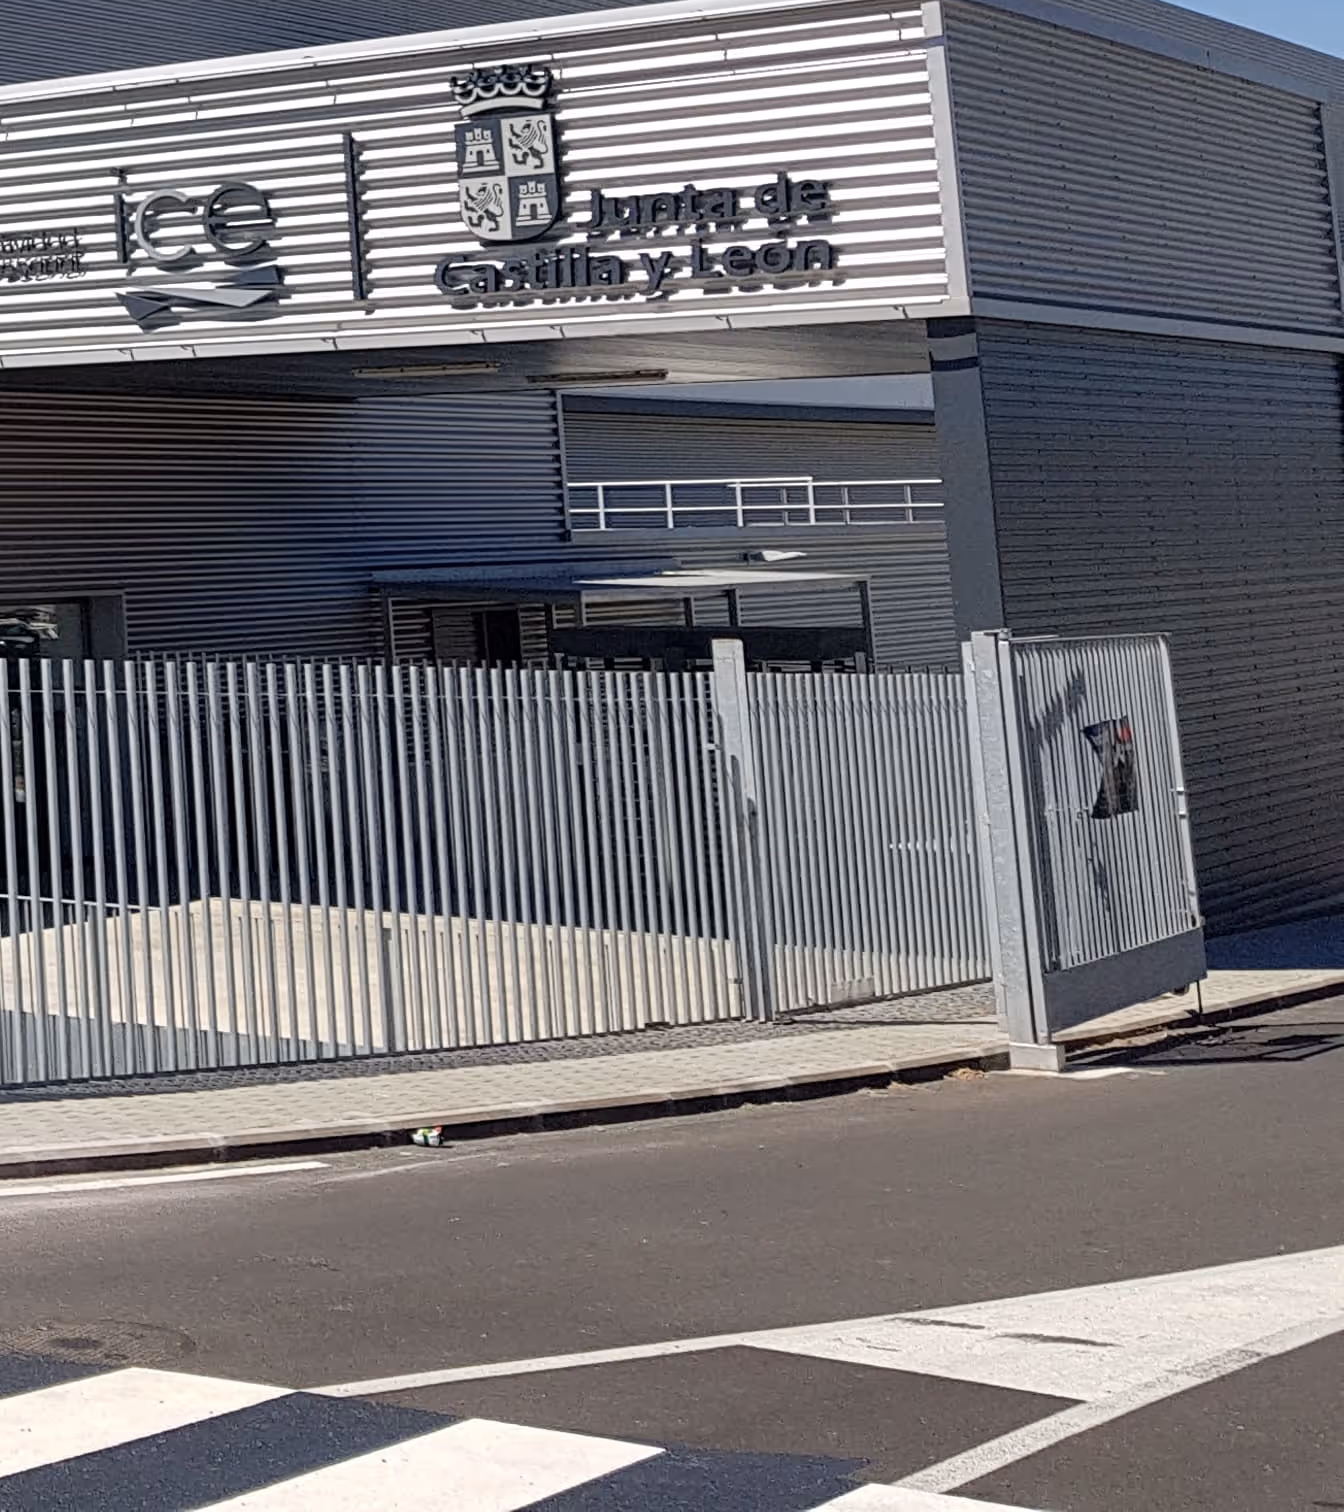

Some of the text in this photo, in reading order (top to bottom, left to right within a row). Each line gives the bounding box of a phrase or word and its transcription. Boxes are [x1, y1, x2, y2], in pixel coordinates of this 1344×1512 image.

[591, 171, 830, 230] Junta de
[435, 230, 836, 297] Castilla y León
